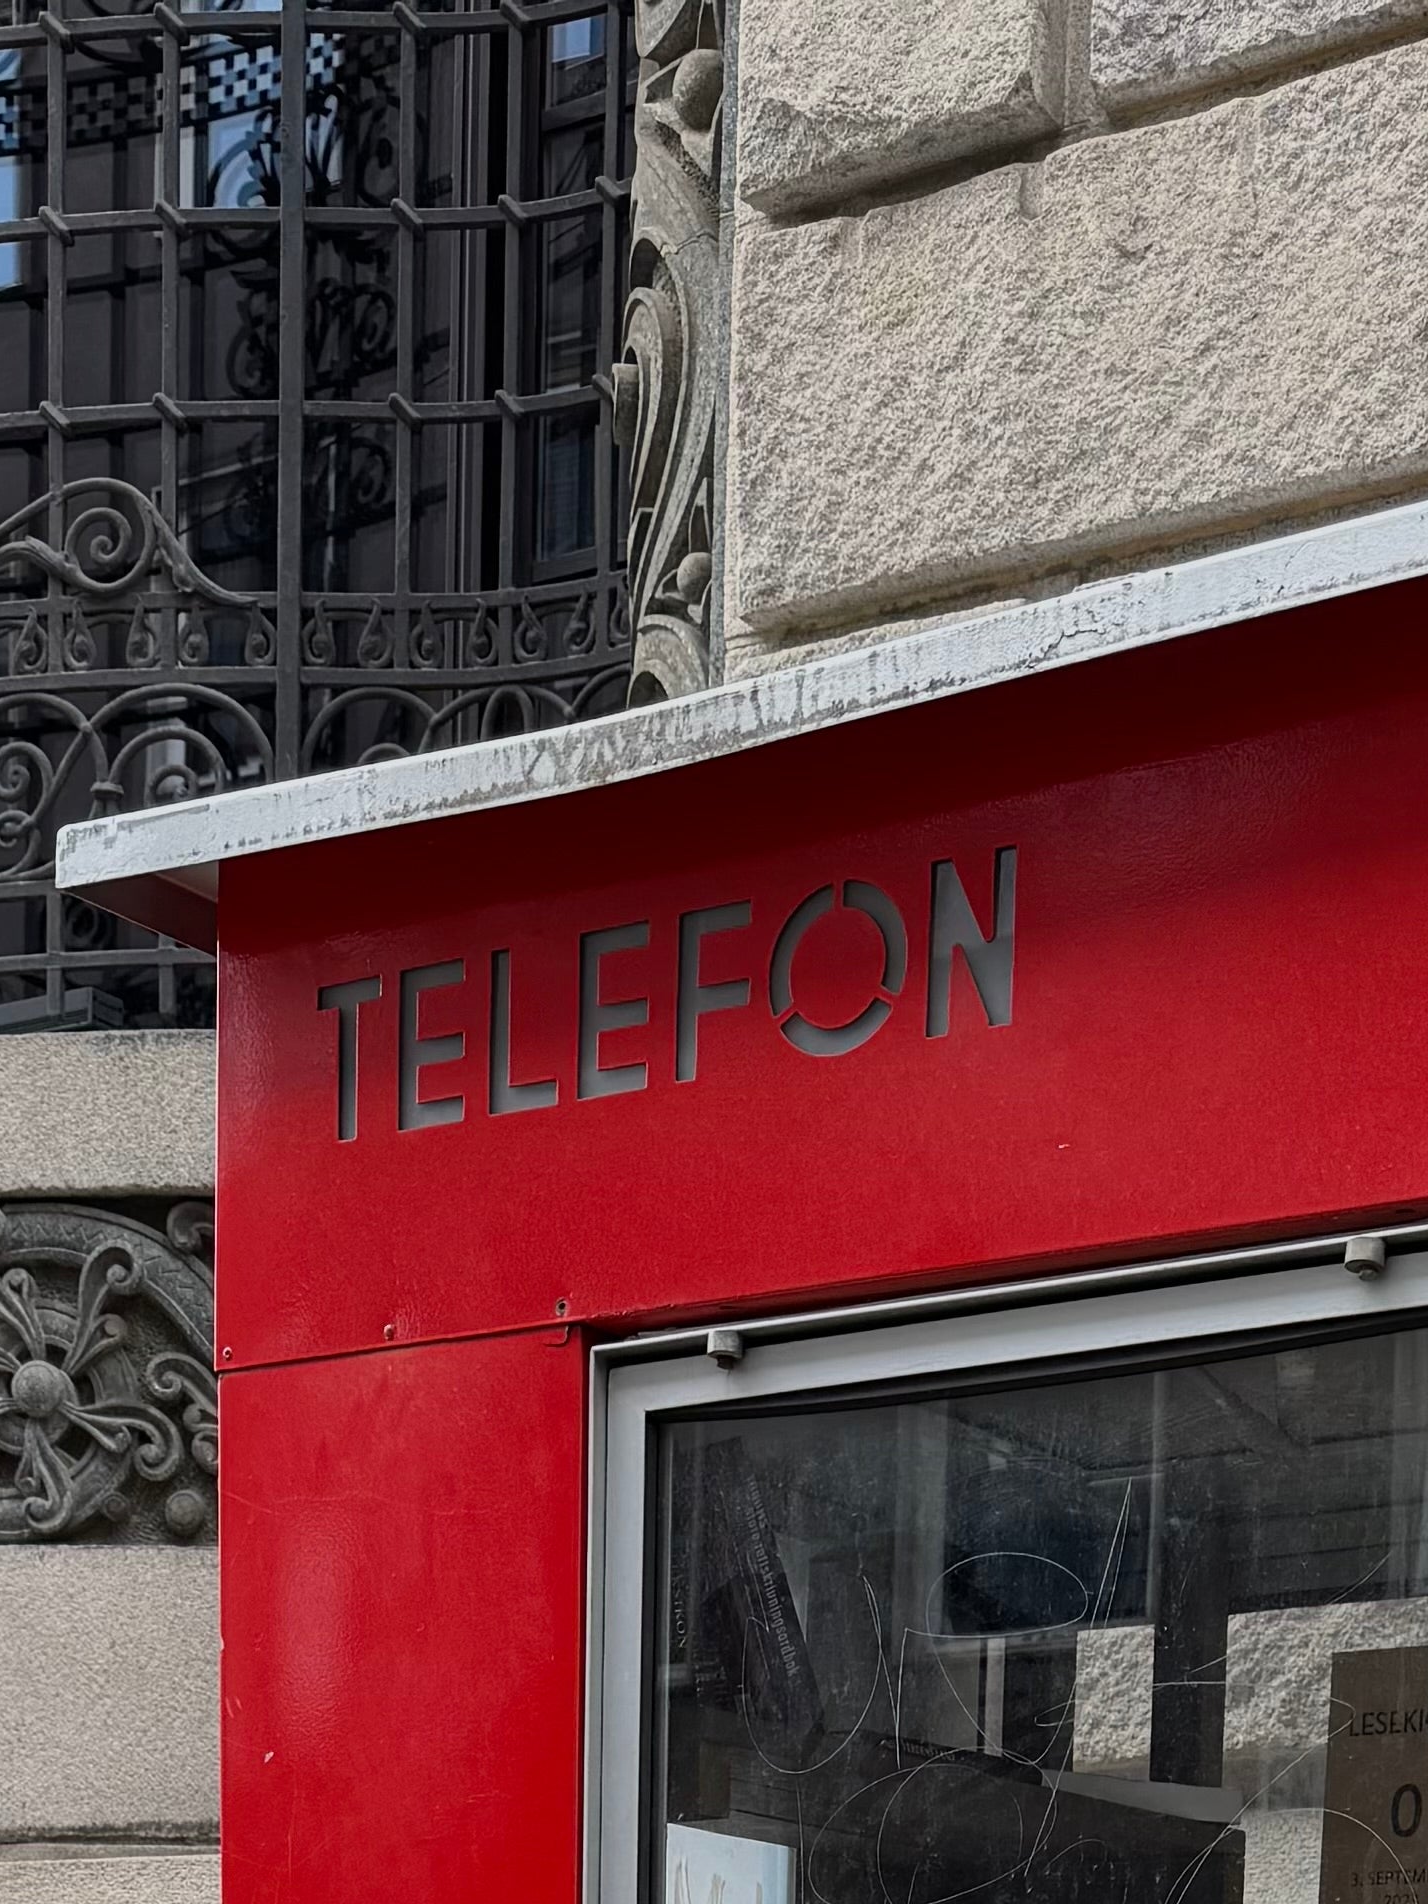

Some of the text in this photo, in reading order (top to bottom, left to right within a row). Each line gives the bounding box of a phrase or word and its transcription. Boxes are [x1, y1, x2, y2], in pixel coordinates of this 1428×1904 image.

[317, 845, 1018, 1141] TELEFON
[1390, 1783, 1423, 1838] 0
[1350, 1872, 1363, 1887] 3.
